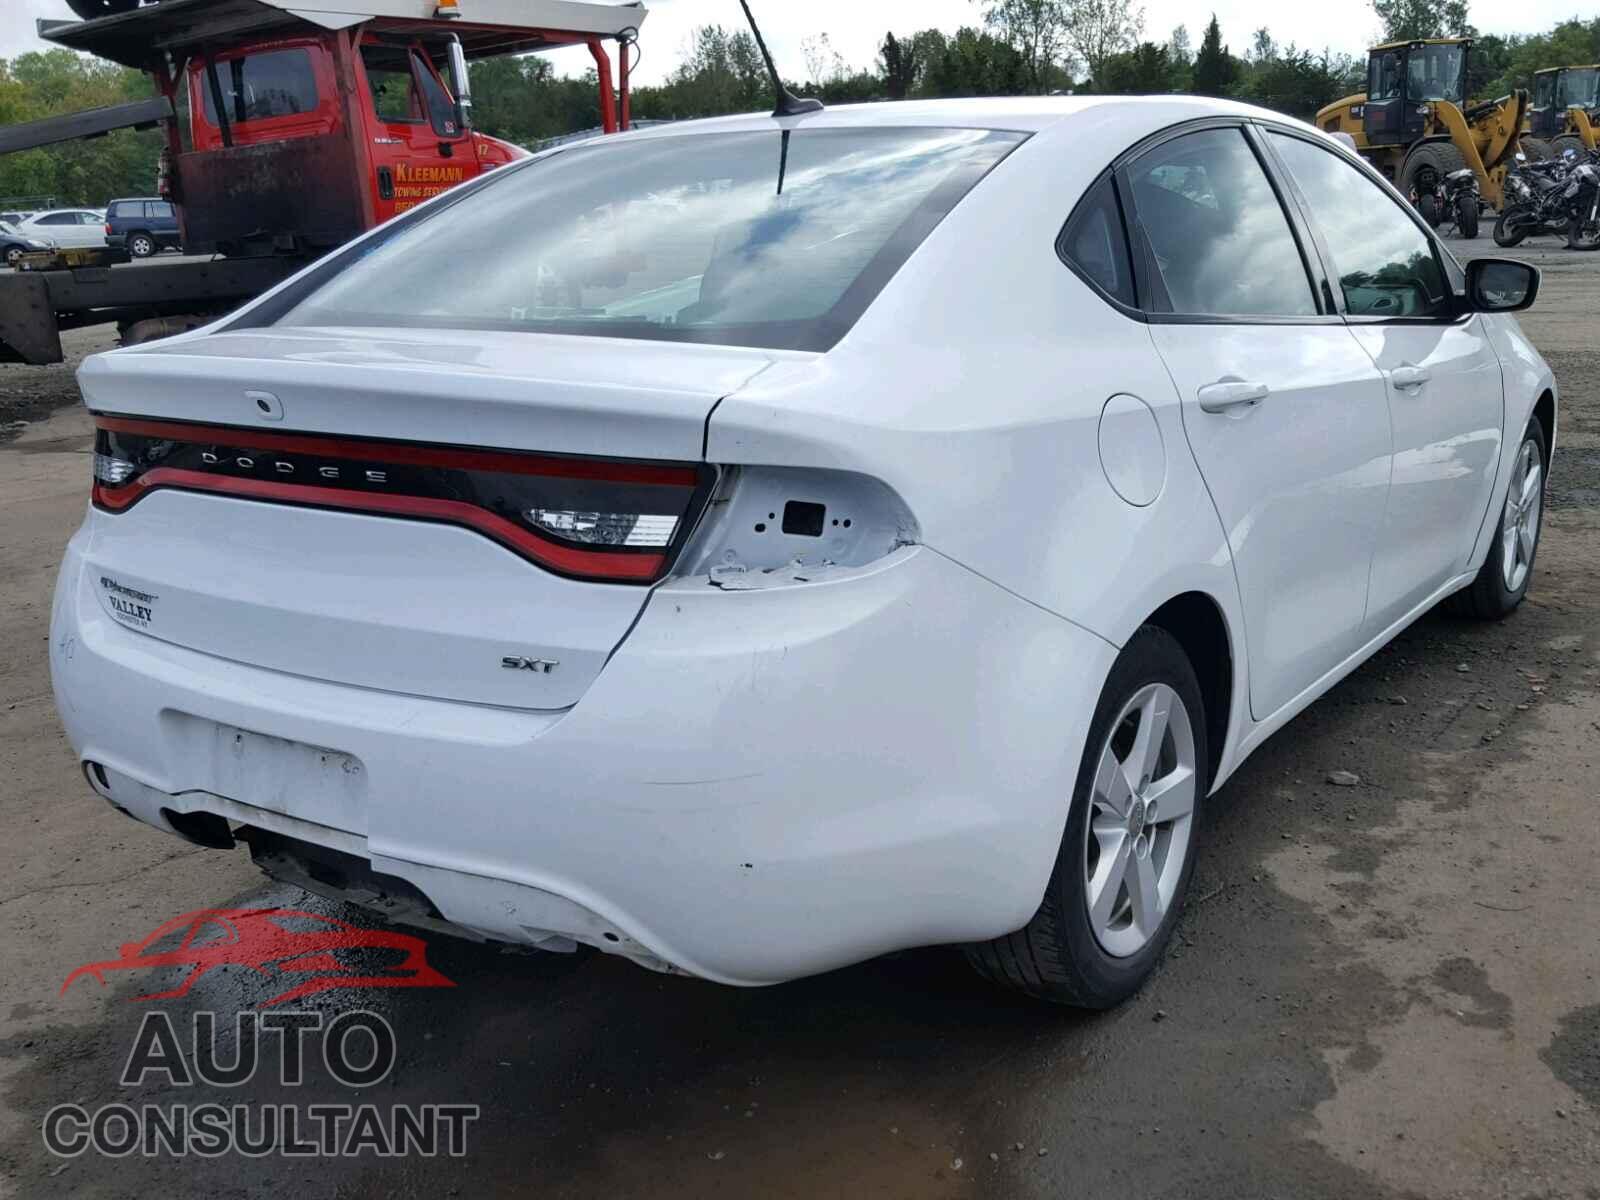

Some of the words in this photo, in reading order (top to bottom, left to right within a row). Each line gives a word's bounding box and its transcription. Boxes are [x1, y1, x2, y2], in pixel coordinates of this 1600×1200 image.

[395, 163, 464, 183] KLEEMANN
[394, 187, 421, 198] TOWING
[201, 452, 387, 483] DODGE
[109, 596, 152, 622] VALLEY
[501, 655, 560, 673] SXT
